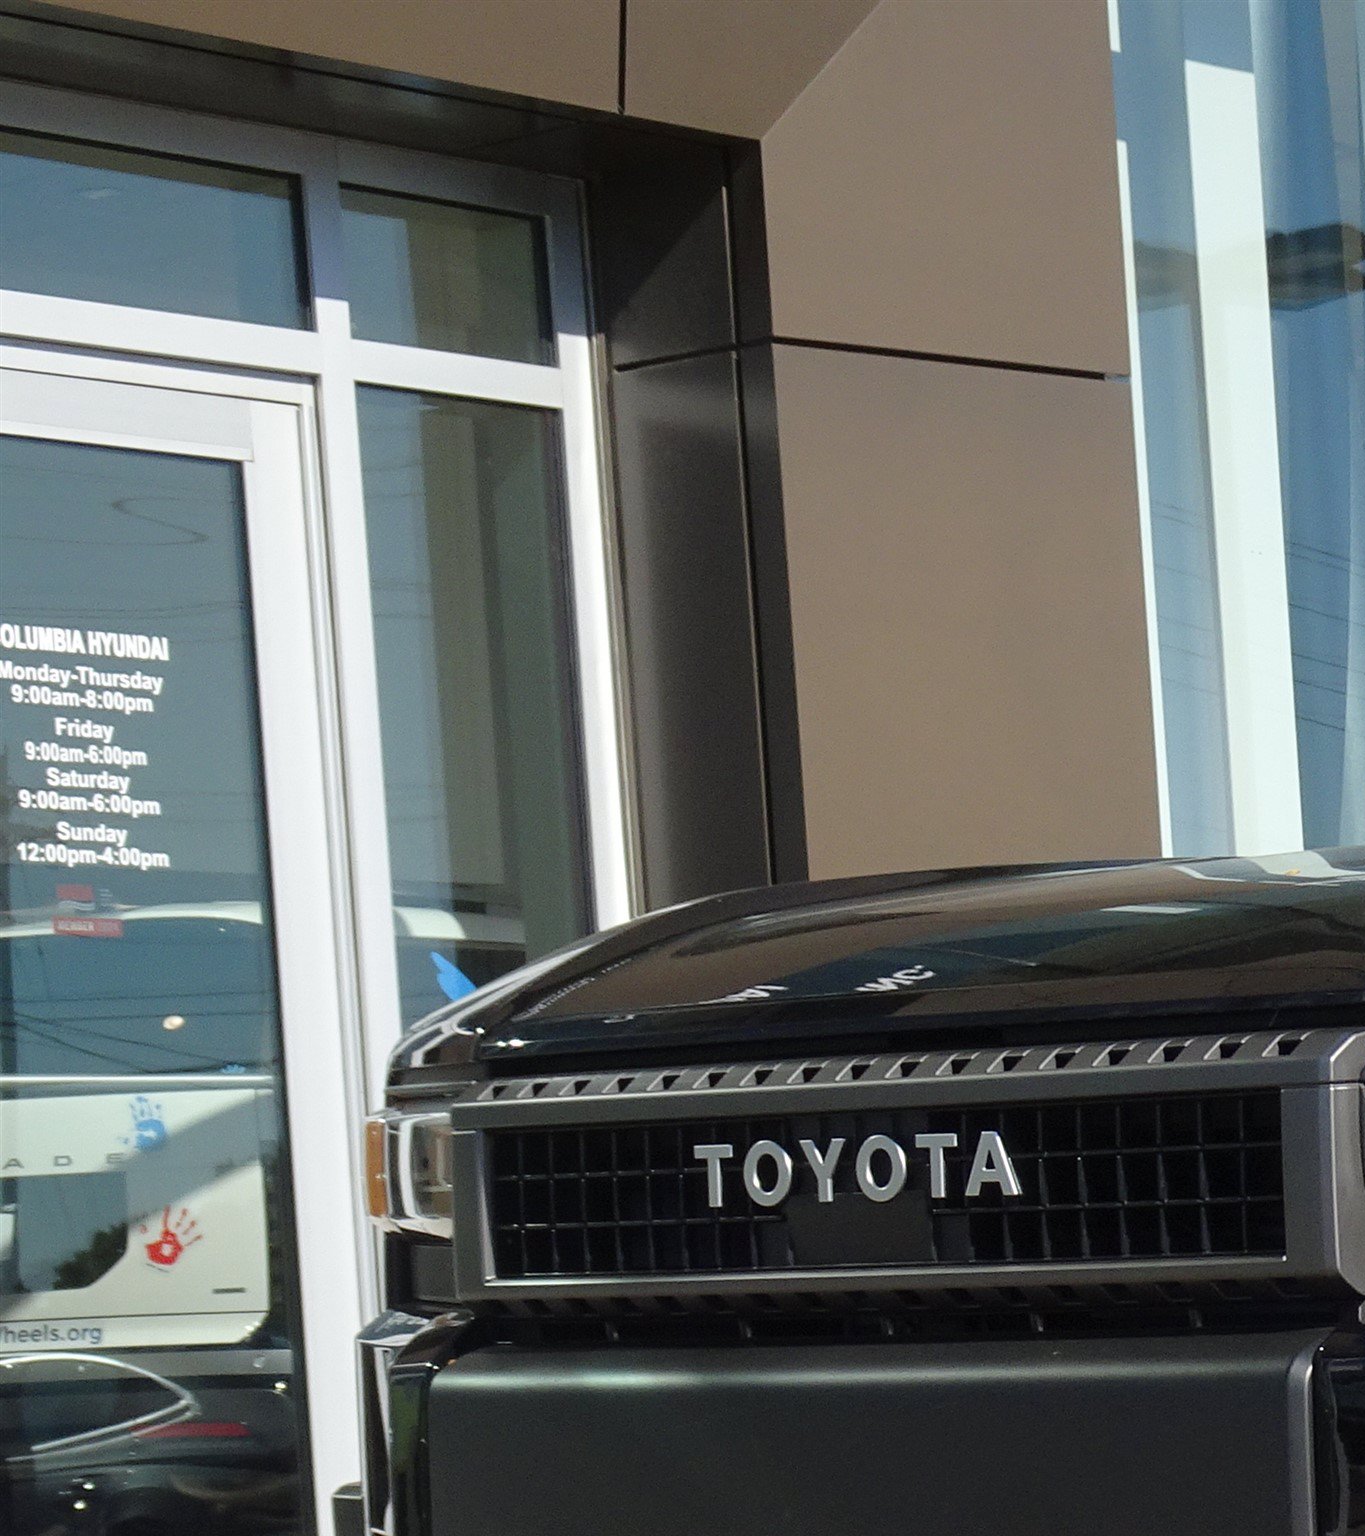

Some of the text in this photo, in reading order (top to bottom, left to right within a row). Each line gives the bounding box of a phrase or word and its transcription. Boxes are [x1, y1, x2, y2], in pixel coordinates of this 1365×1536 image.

[0, 624, 170, 661] OLUMBIA HYUNDAI
[0, 660, 164, 695] Monday-Thursday
[11, 684, 154, 715] 9:00am-8:00pm
[54, 717, 114, 743] Friday
[24, 741, 148, 769] 9:00am-6:00pm
[46, 766, 131, 794] Saturday
[18, 789, 161, 818] 9:00am-6:00pm
[56, 821, 128, 847] Sunday
[16, 842, 171, 870] 12:00pm-4:00pm
[694, 1130, 1023, 1208] TOYOTA
[0, 1324, 103, 1345] heels.org
